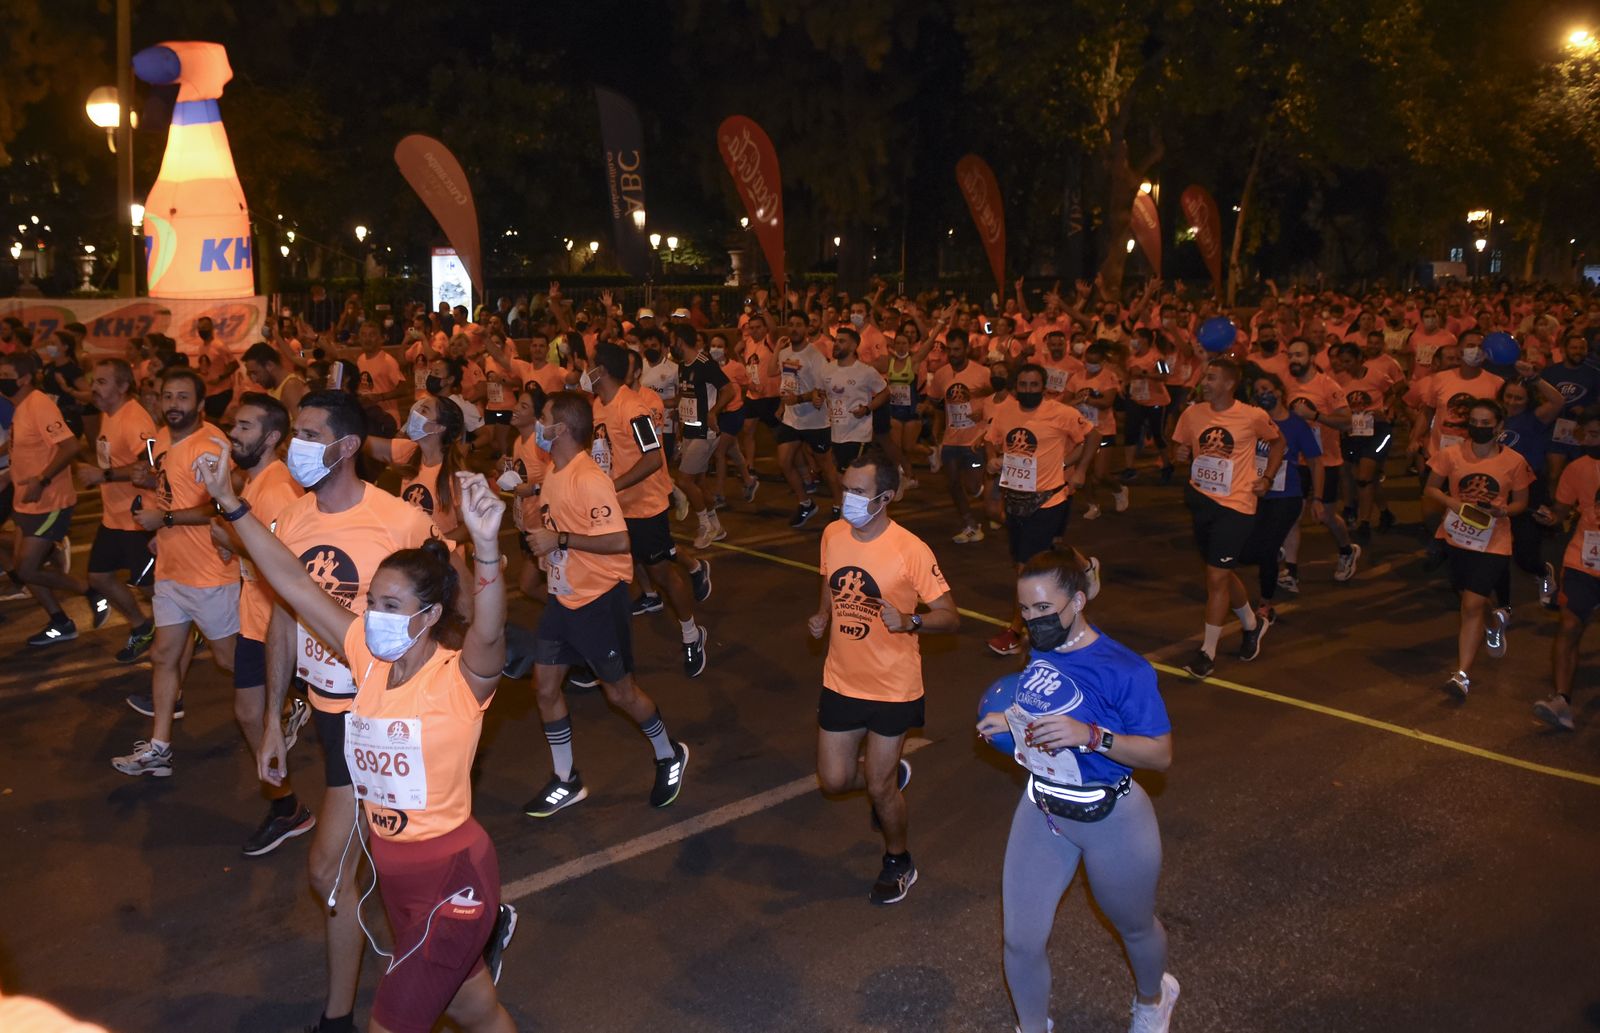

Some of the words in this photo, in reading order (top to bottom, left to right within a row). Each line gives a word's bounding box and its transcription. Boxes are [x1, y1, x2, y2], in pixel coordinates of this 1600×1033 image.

[1006, 466, 1031, 480] 7752
[1197, 468, 1224, 483] 5631
[840, 603, 878, 617] NOCTURNA
[305, 637, 336, 666] 892
[1023, 667, 1062, 696] life
[353, 748, 410, 777] 8926
